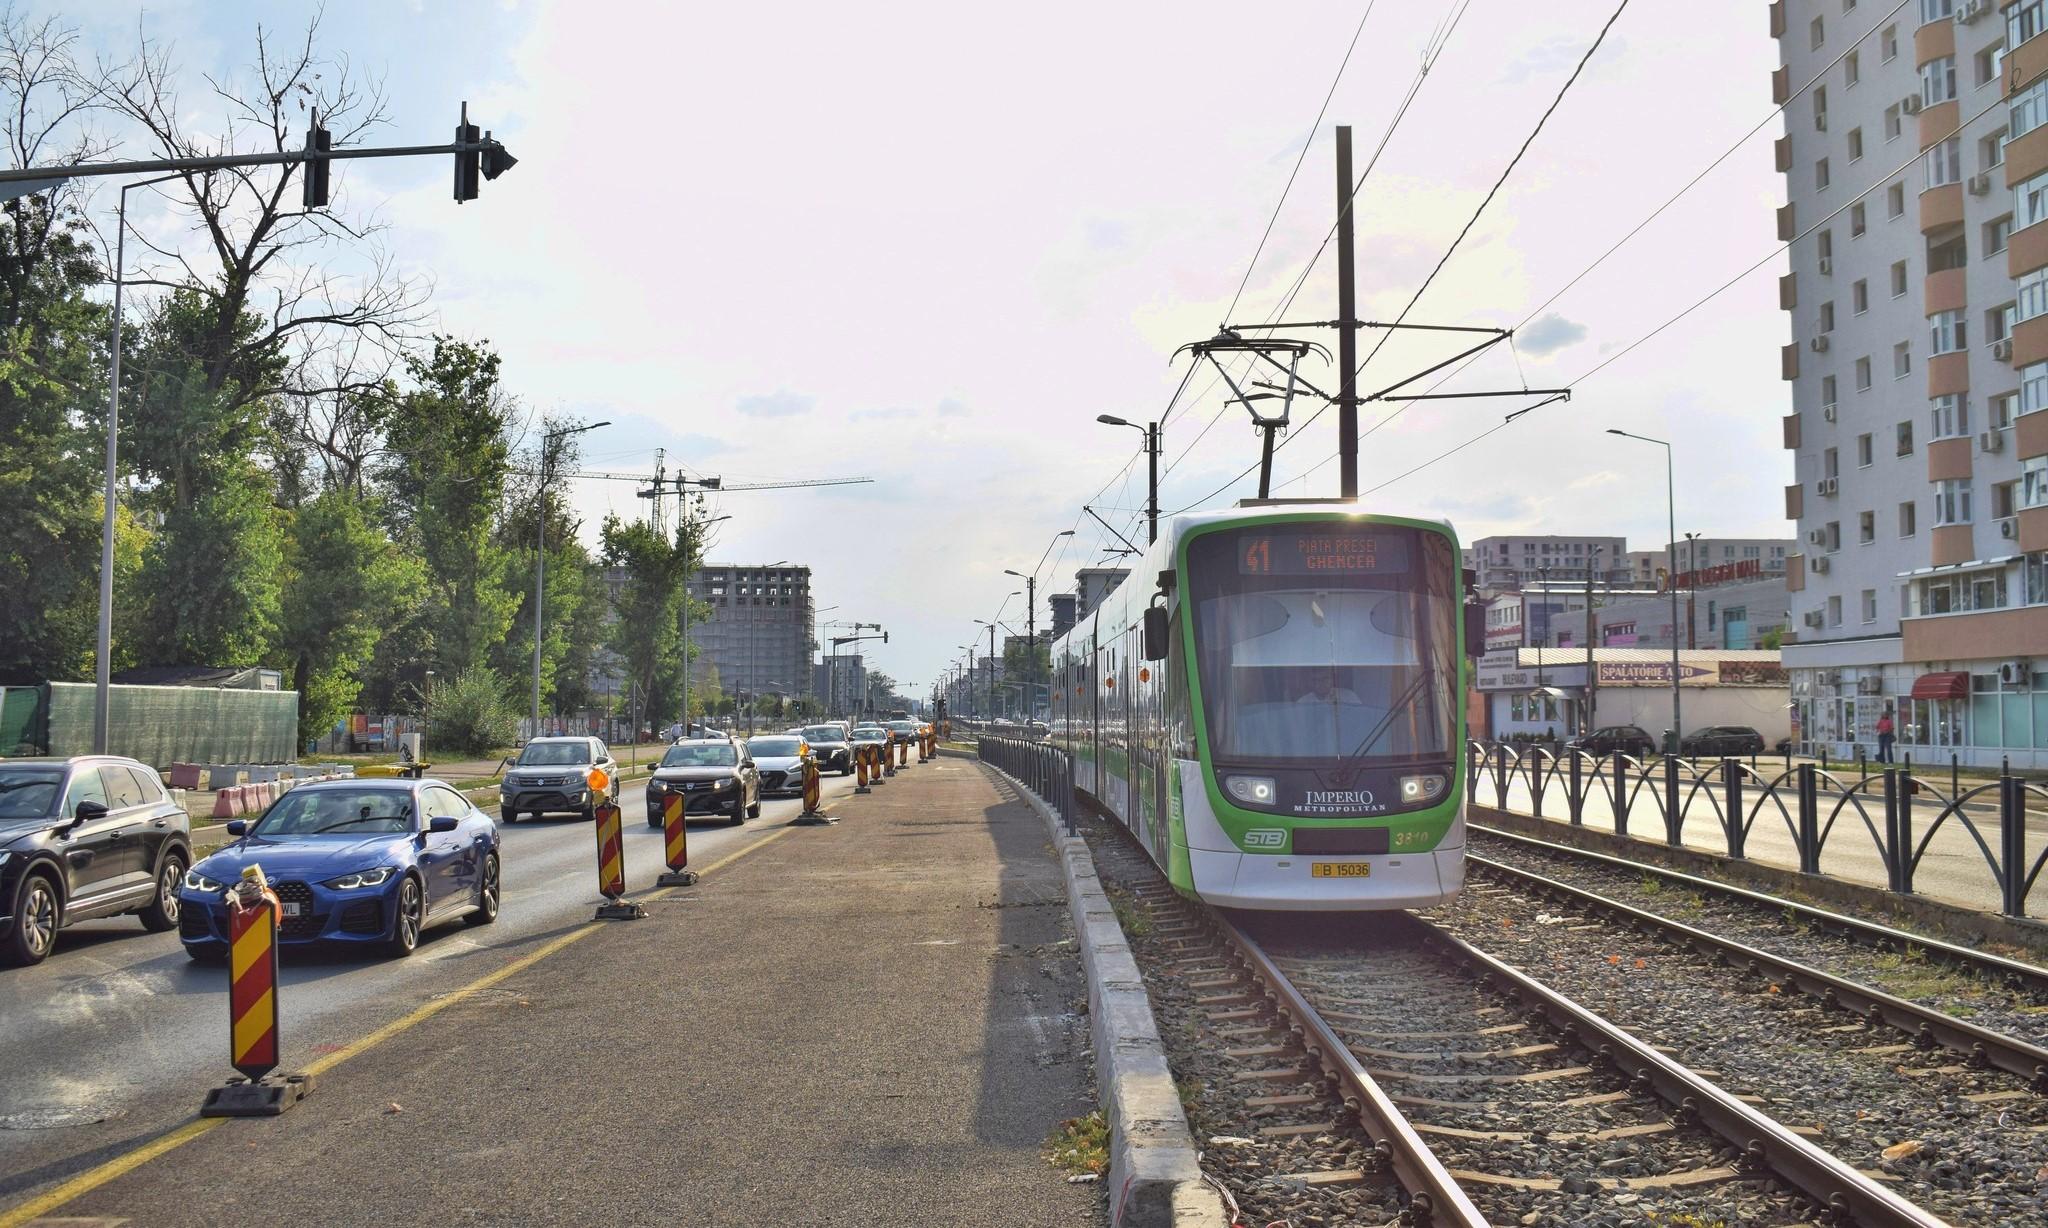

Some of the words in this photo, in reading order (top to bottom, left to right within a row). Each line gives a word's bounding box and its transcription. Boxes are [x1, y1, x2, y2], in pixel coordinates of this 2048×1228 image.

[1336, 539, 1377, 552] PRESEI
[1247, 540, 1272, 571] 41
[1602, 667, 1663, 677] SPALATORIE
[1666, 667, 1693, 677] ATO
[1305, 790, 1374, 805] IMPERIO
[1294, 803, 1386, 813] METROPOLITAN
[1244, 831, 1283, 845] STB
[1323, 864, 1331, 876] B
[1337, 864, 1369, 876] 15036
